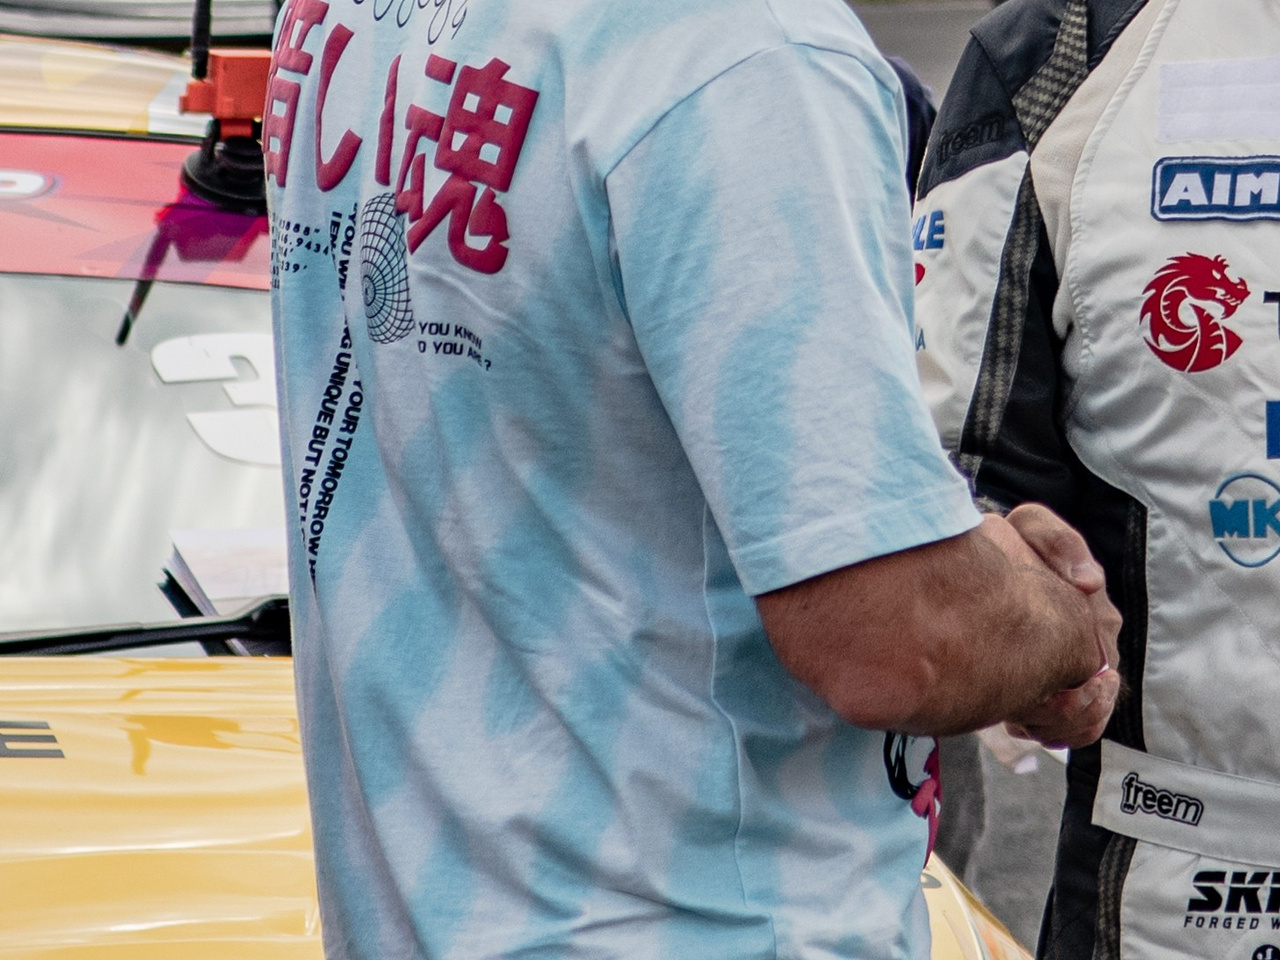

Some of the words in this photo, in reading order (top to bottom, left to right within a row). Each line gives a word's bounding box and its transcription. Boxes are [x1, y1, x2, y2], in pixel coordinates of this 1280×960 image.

[419, 321, 450, 336] YOU
[432, 341, 464, 355] YOU
[316, 352, 352, 426] UNIQUE
[305, 425, 330, 467] BUT
[299, 468, 316, 513] NOT
[308, 438, 353, 556] TOMORROW
[1120, 772, 1204, 826] freem
[1183, 915, 1260, 930] FORGED
